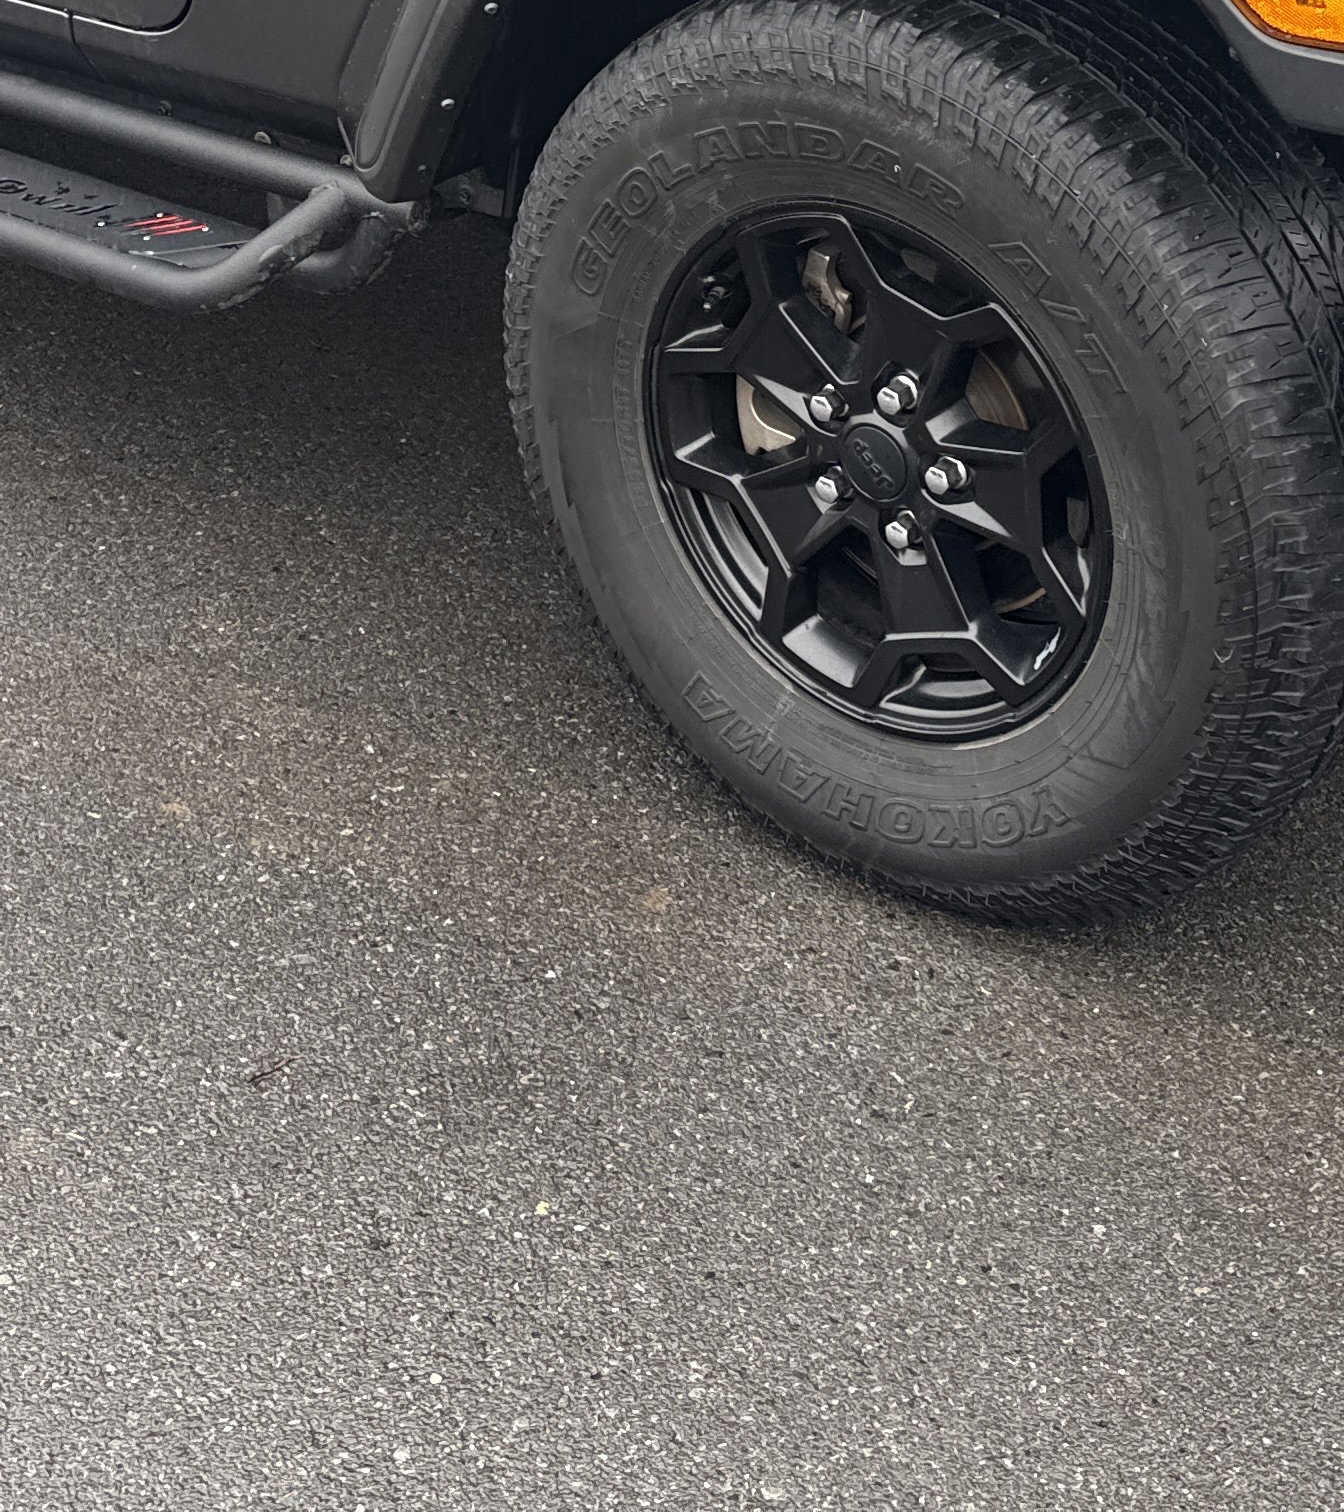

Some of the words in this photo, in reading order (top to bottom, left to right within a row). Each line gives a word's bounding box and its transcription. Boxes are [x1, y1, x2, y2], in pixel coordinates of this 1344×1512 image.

[570, 120, 966, 297] GEOLANDAR
[987, 240, 1129, 394] A/T
[681, 669, 1074, 849] YOKOHAMA
